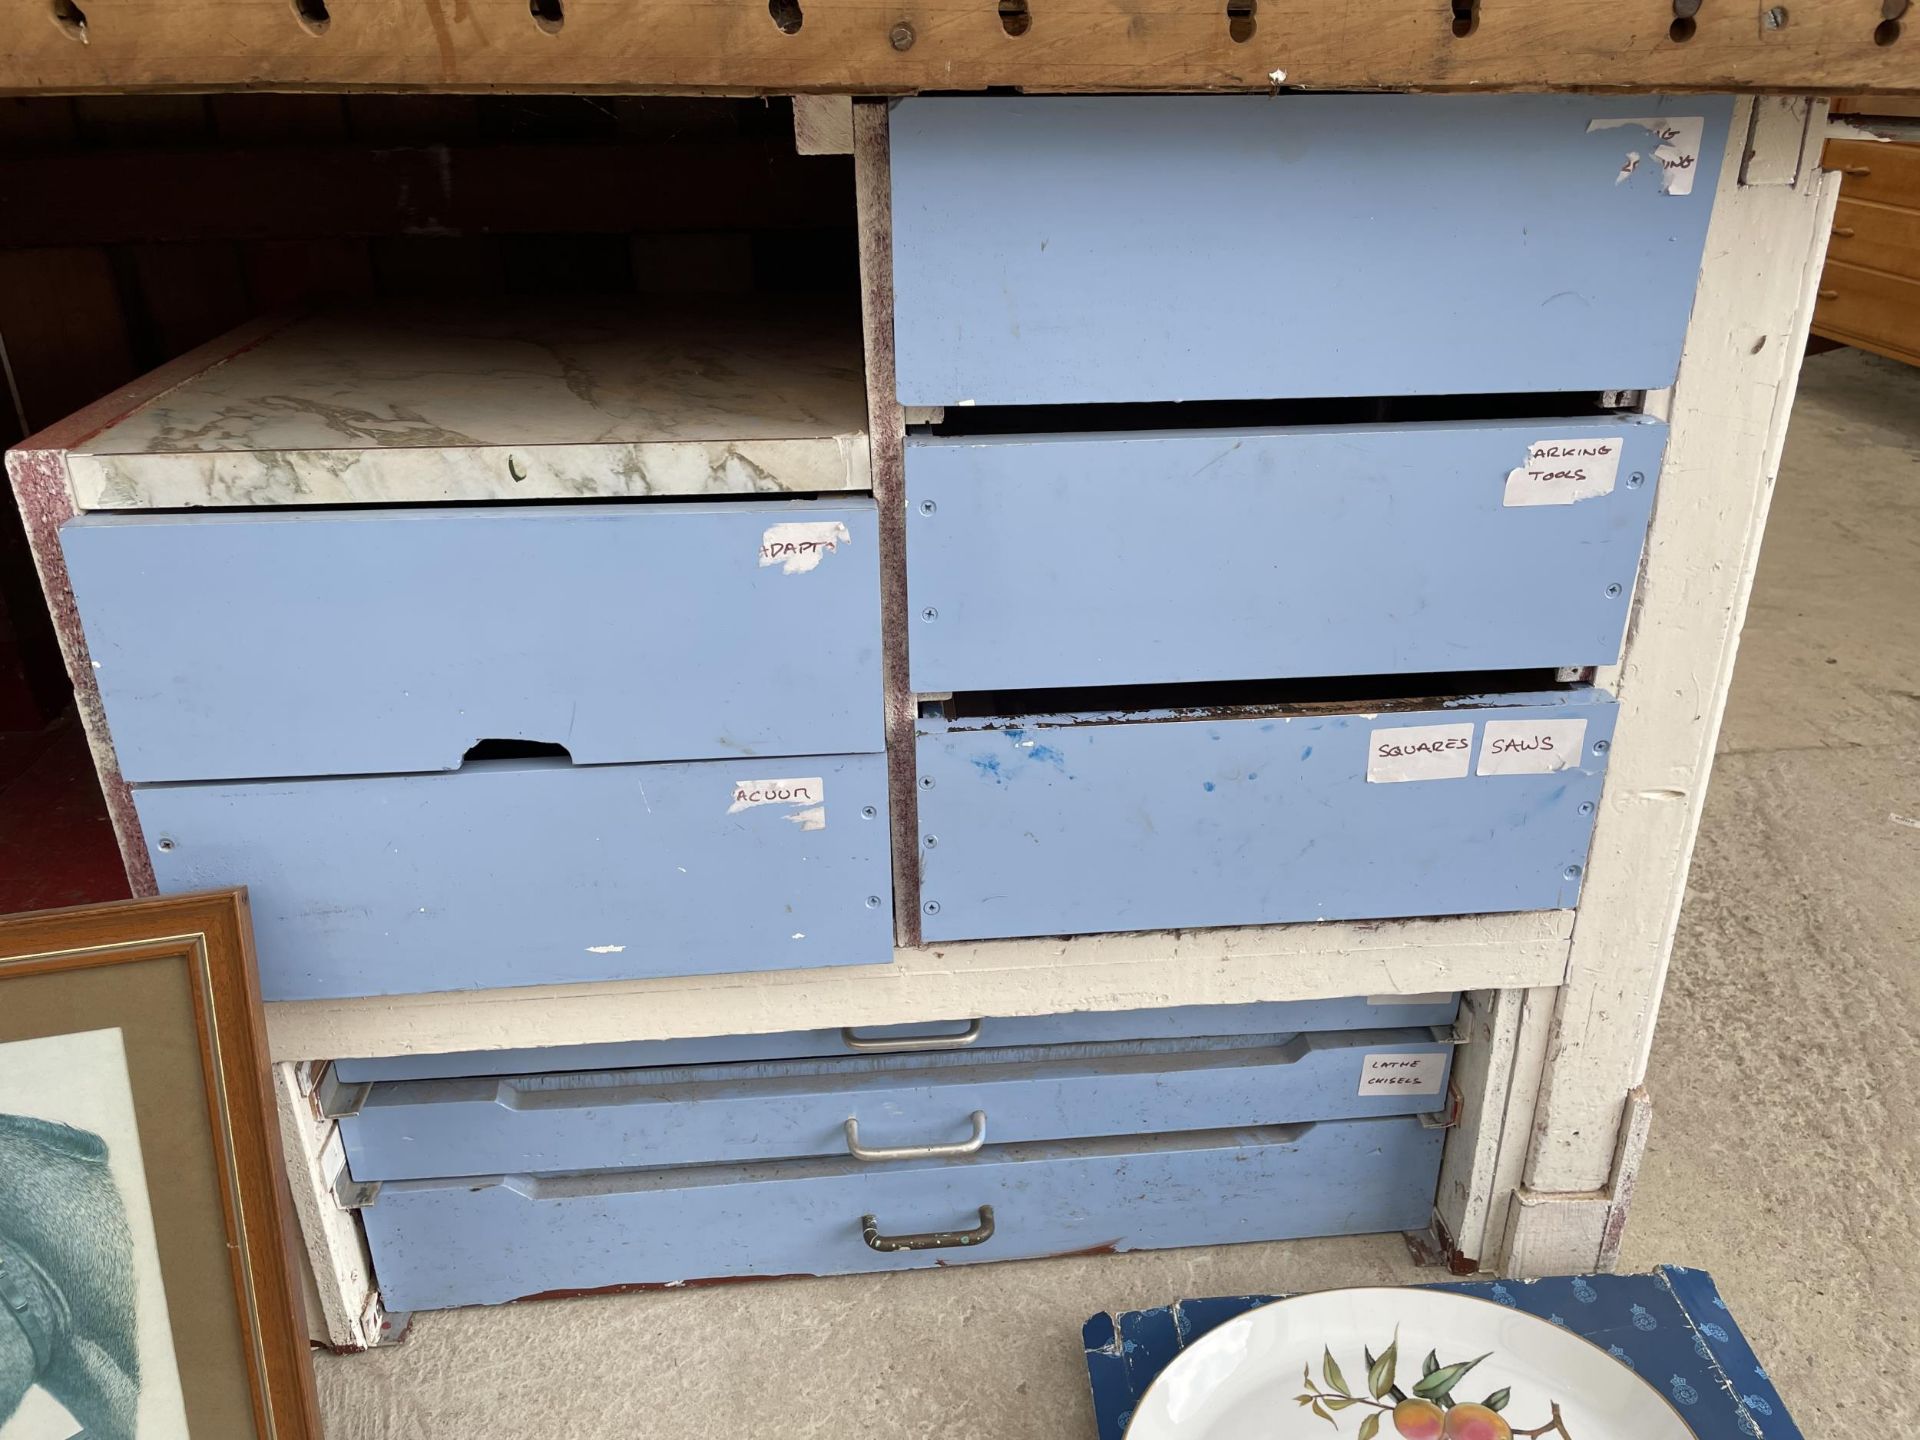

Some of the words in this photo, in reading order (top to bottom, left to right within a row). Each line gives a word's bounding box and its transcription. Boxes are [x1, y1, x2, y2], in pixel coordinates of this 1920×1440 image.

[1528, 469, 1587, 481] TOOLS
[1378, 738, 1469, 758] SQUARES
[1491, 735, 1554, 754] SAWS
[1372, 1060, 1421, 1069] LATHE
[1367, 1077, 1423, 1085] CHISELS
